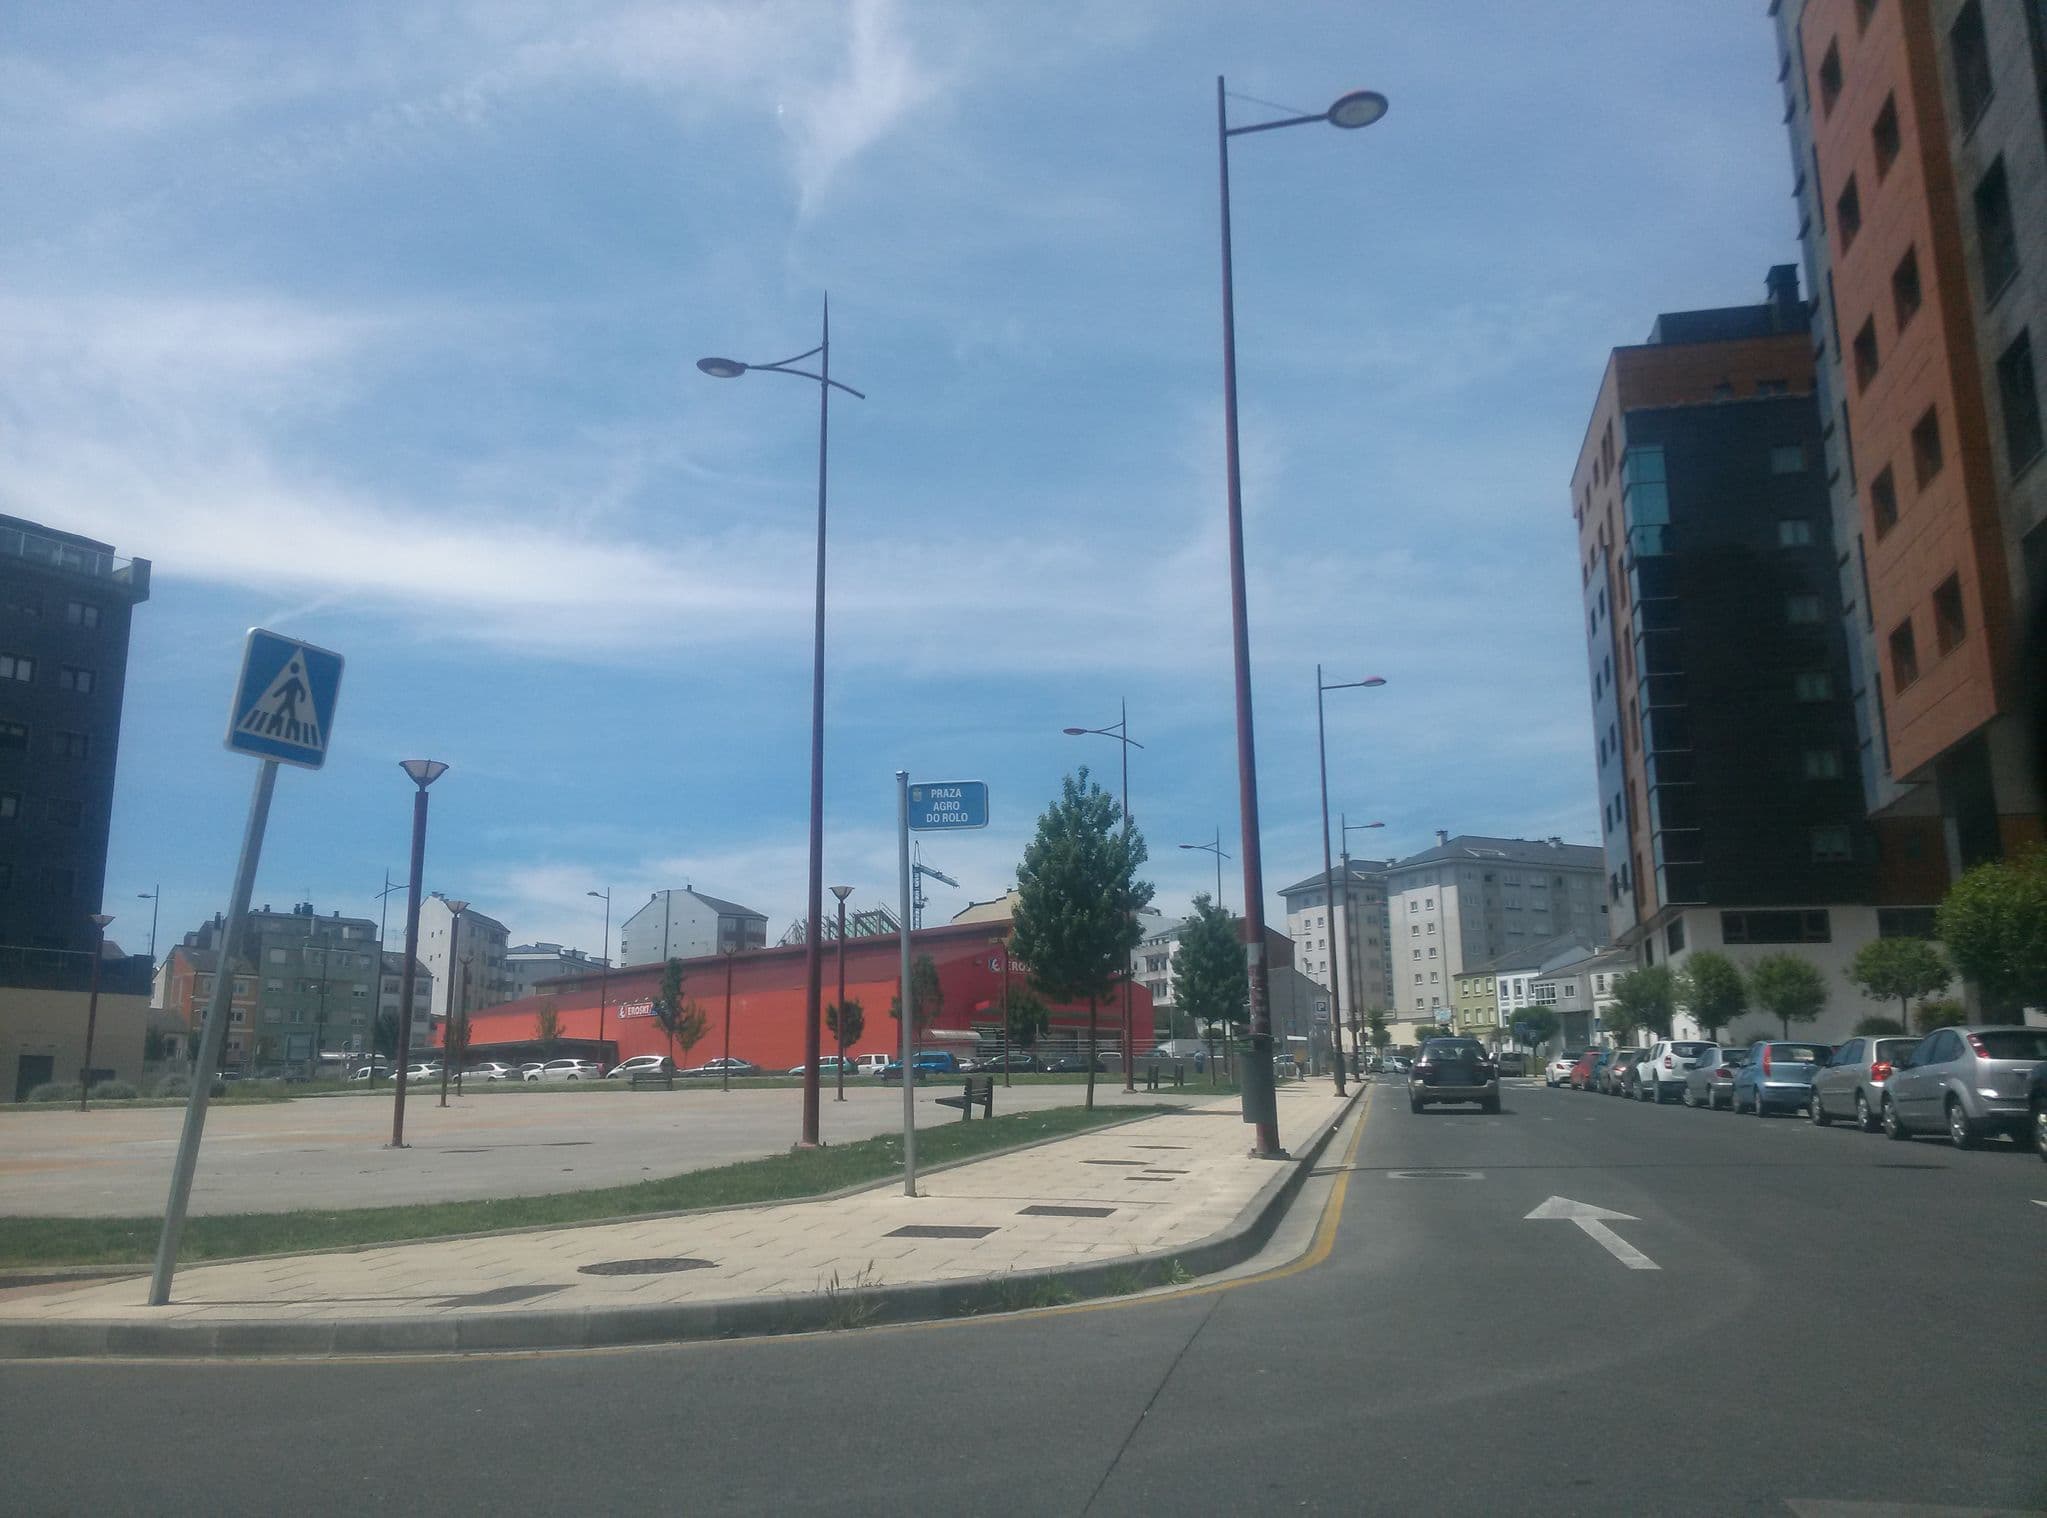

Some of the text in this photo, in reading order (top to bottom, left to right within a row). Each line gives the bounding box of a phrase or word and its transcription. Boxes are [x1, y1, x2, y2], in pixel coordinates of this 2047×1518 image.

[930, 788, 962, 799] PRAZA
[933, 801, 960, 812] AGRO
[926, 812, 968, 823] DO ROLO
[627, 1004, 649, 1016] EROSKI
